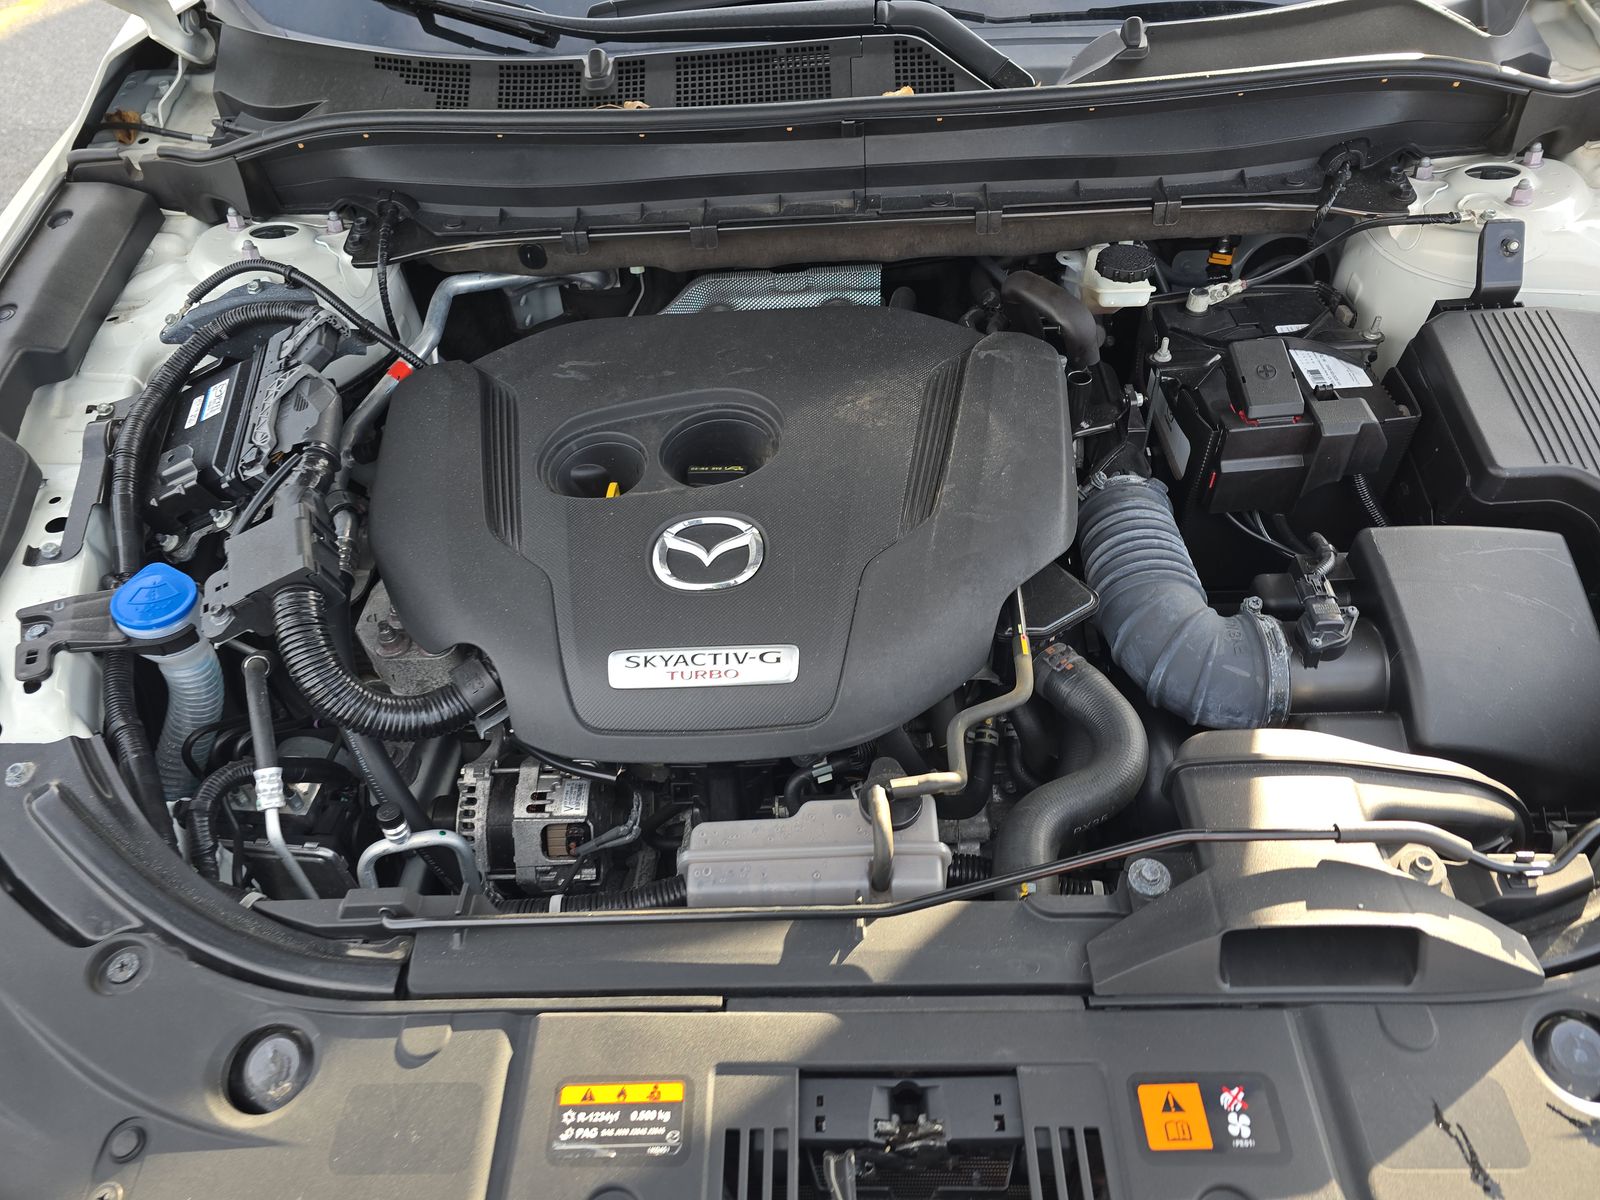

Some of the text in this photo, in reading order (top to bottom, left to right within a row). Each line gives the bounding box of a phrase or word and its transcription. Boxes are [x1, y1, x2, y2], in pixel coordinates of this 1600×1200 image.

[624, 651, 782, 669] SKYACTIV-G
[666, 669, 740, 681] TURBO
[657, 1109, 671, 1122] kg
[574, 1127, 599, 1139] PAG
